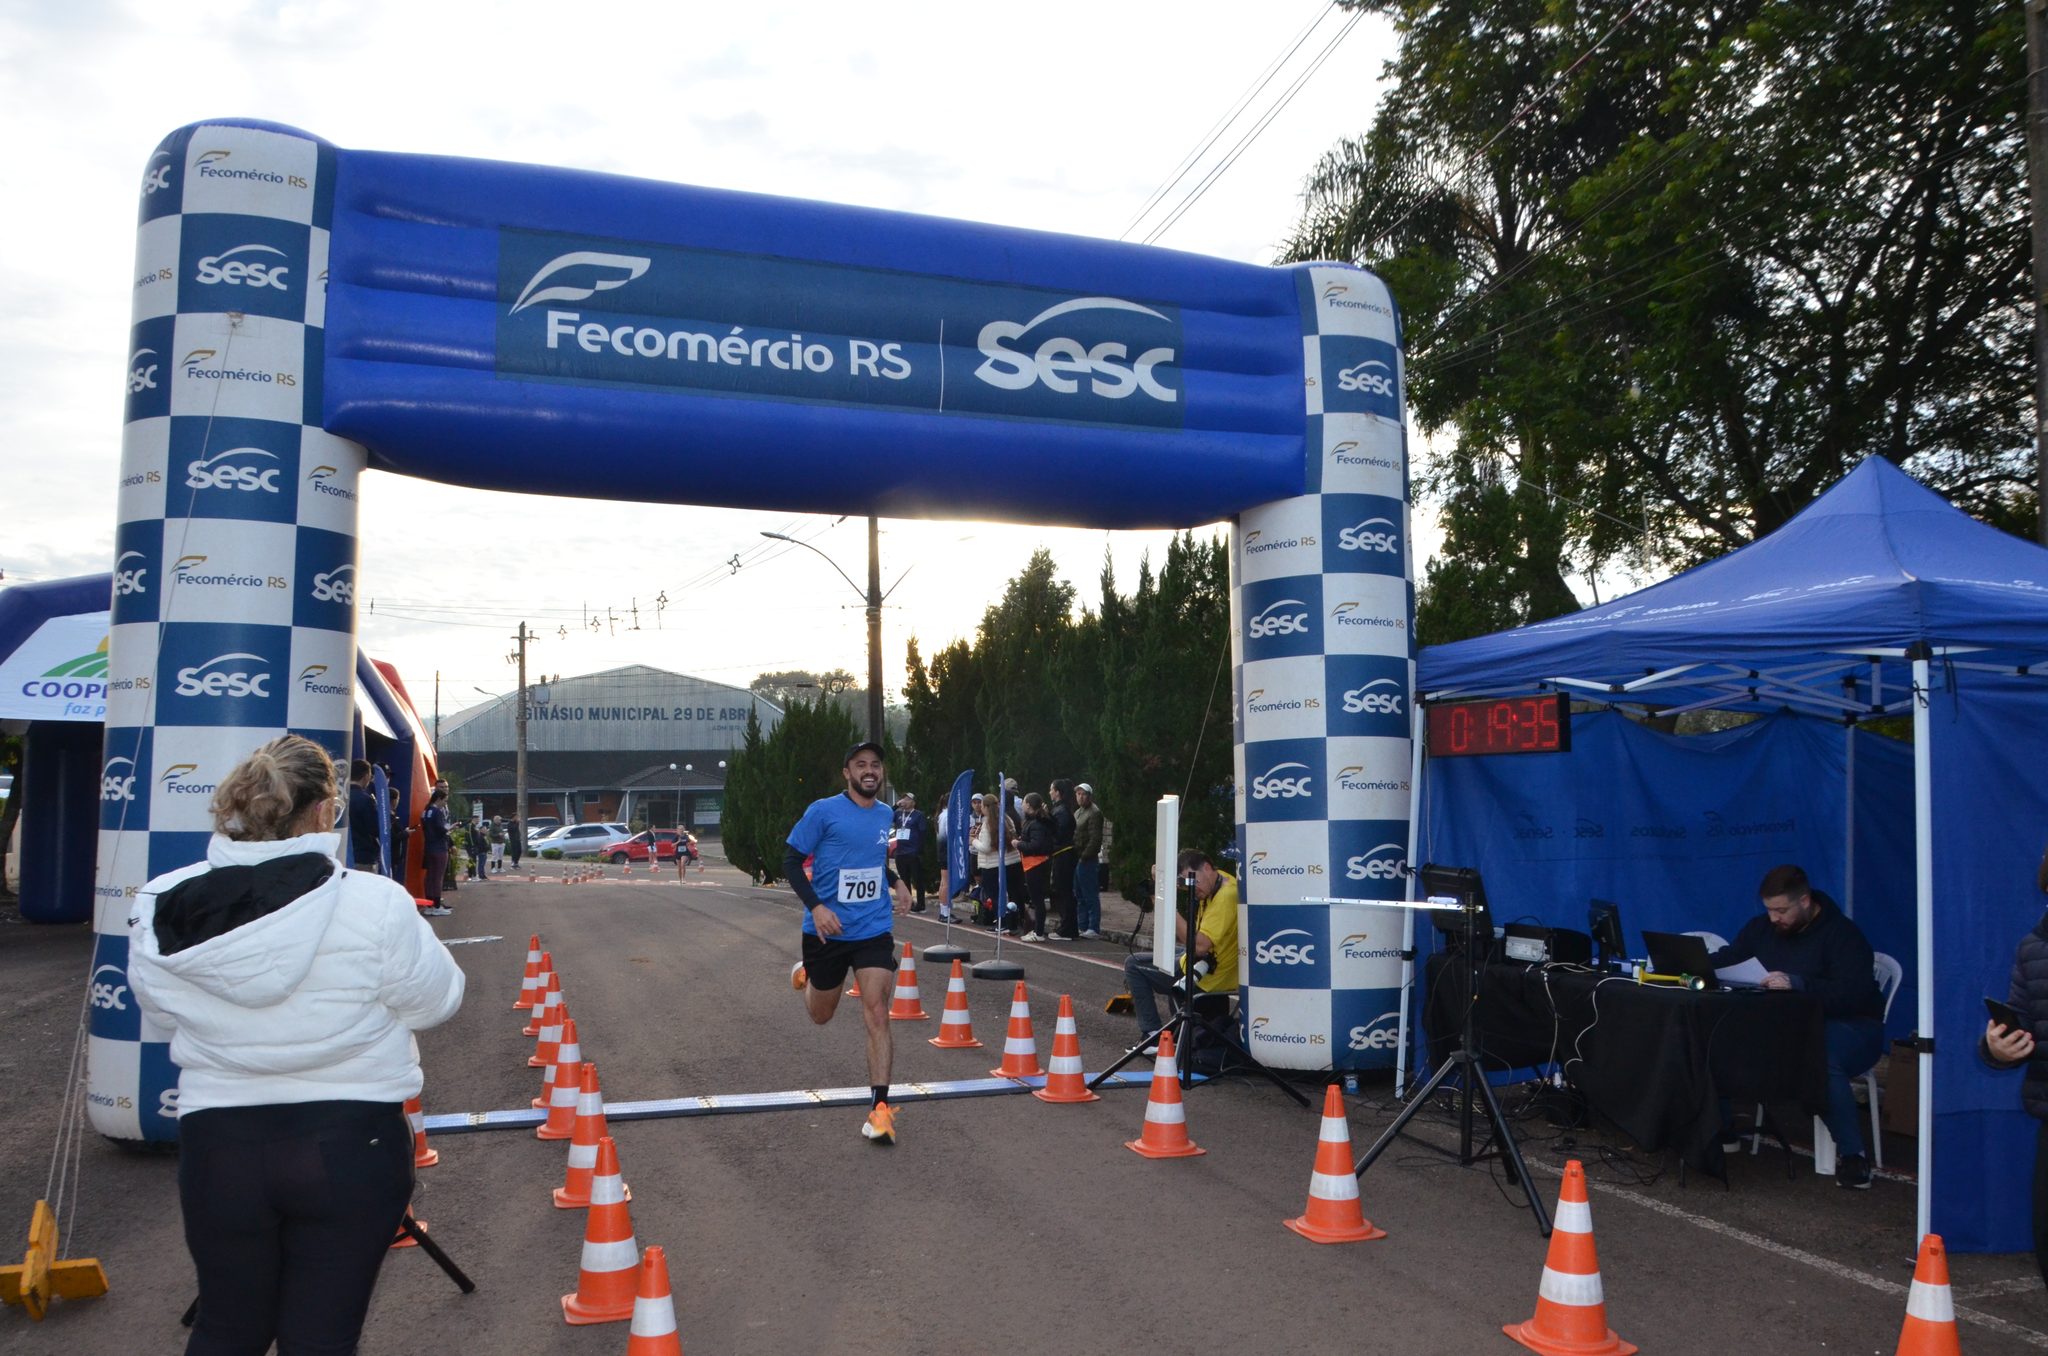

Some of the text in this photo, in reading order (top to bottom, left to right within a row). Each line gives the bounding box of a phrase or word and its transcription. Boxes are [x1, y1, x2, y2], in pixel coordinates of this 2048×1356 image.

[200, 166, 307, 189] Fecomércio RS
[1330, 298, 1382, 314] Fecomércio
[546, 310, 912, 380] Fecomércio RS
[974, 320, 1178, 403] Sesc
[127, 364, 158, 395] esc
[187, 366, 296, 387] Fecomércio RS
[1337, 454, 1391, 470] Fecomércio
[146, 471, 161, 483] RS
[1246, 536, 1316, 556] Fecomércio RS
[115, 568, 147, 596] esc
[177, 572, 287, 590] Fecomércio RS
[311, 572, 355, 606] Ses
[1338, 615, 1394, 628] Fecomércio
[22, 680, 107, 699] COOP
[135, 677, 151, 690] RS
[588, 706, 669, 721] MUNICIPAL
[674, 707, 693, 721] 29
[697, 707, 714, 721] DE
[1249, 700, 1301, 714] Fecomércio
[1304, 698, 1320, 709] RS
[100, 775, 137, 801] esc
[168, 781, 217, 795] Fecom
[1341, 779, 1399, 791] Fecomércio
[1252, 864, 1304, 876] Fecomércio
[1307, 864, 1324, 875] RS
[845, 880, 876, 901] 709
[90, 981, 128, 1011] esc
[1254, 1030, 1326, 1045] Fecomércio RS
[117, 1095, 132, 1110] RS
